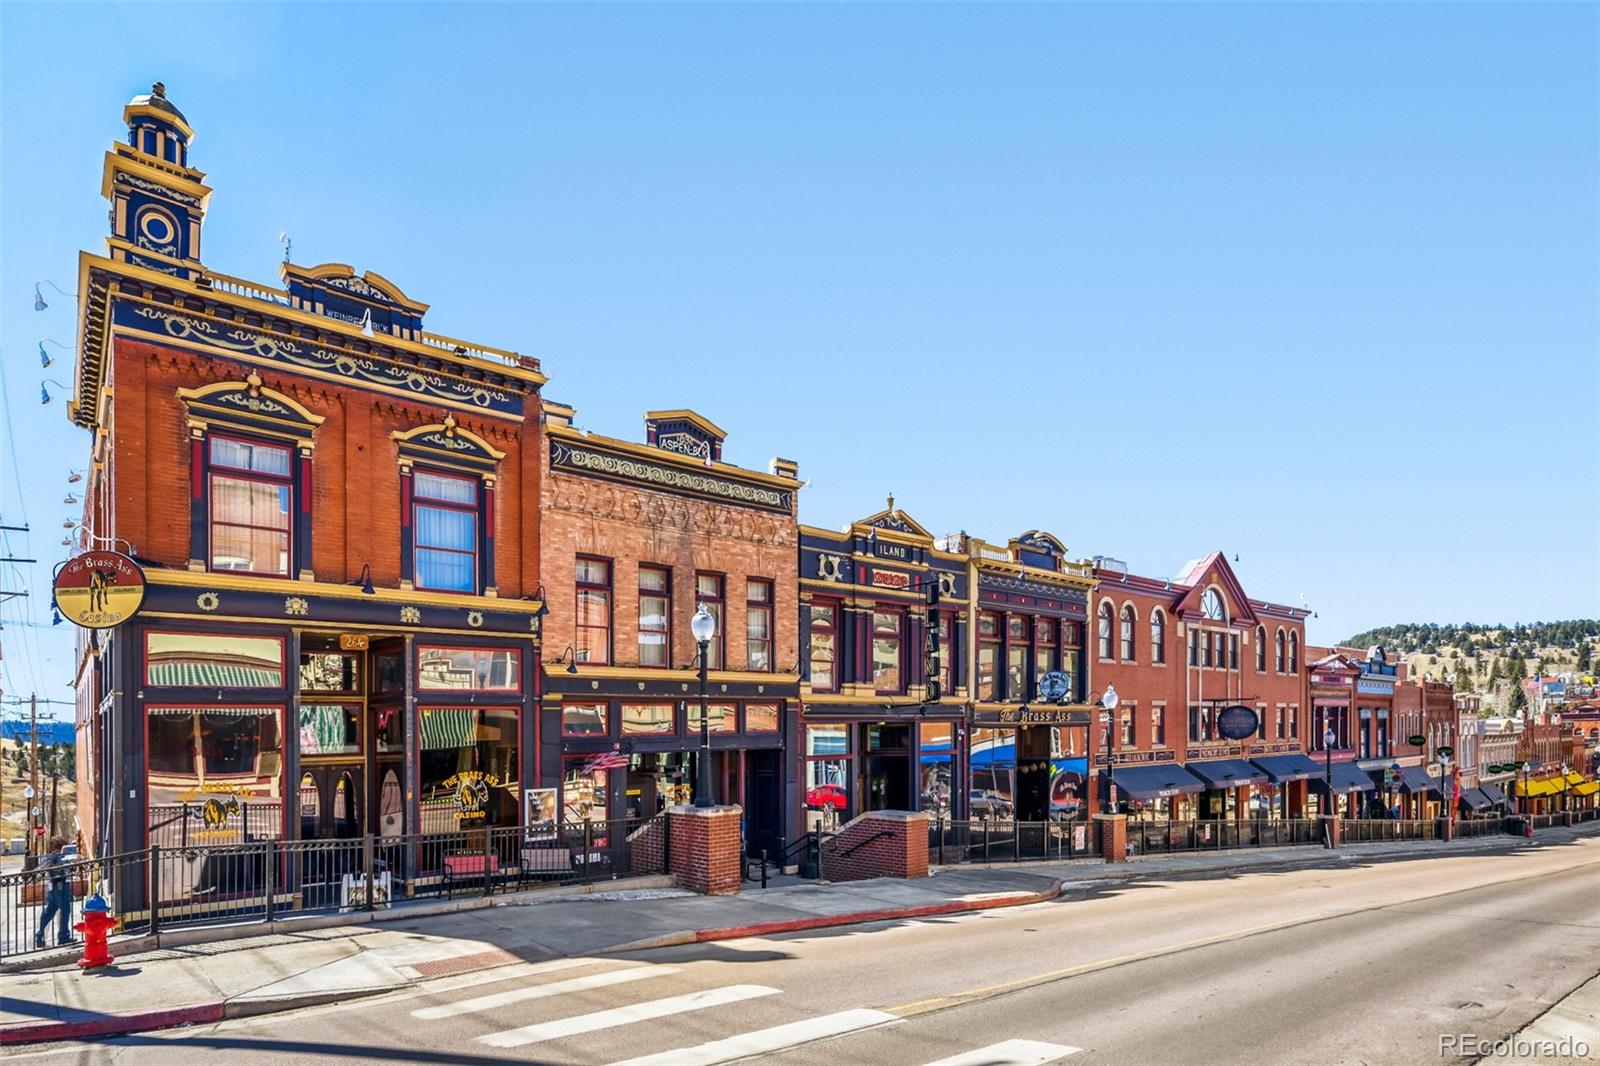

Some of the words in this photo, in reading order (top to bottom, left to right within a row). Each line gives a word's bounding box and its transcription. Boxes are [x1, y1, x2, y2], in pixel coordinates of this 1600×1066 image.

[880, 545, 905, 558] ILAND
[84, 557, 114, 569] Brass
[116, 559, 133, 575] Ass
[1000, 709, 1015, 724] The
[1055, 710, 1071, 723] Ass
[442, 775, 458, 789] THE
[458, 771, 483, 781] BRASS
[484, 773, 499, 788] ASS
[453, 810, 486, 819] CASINO
